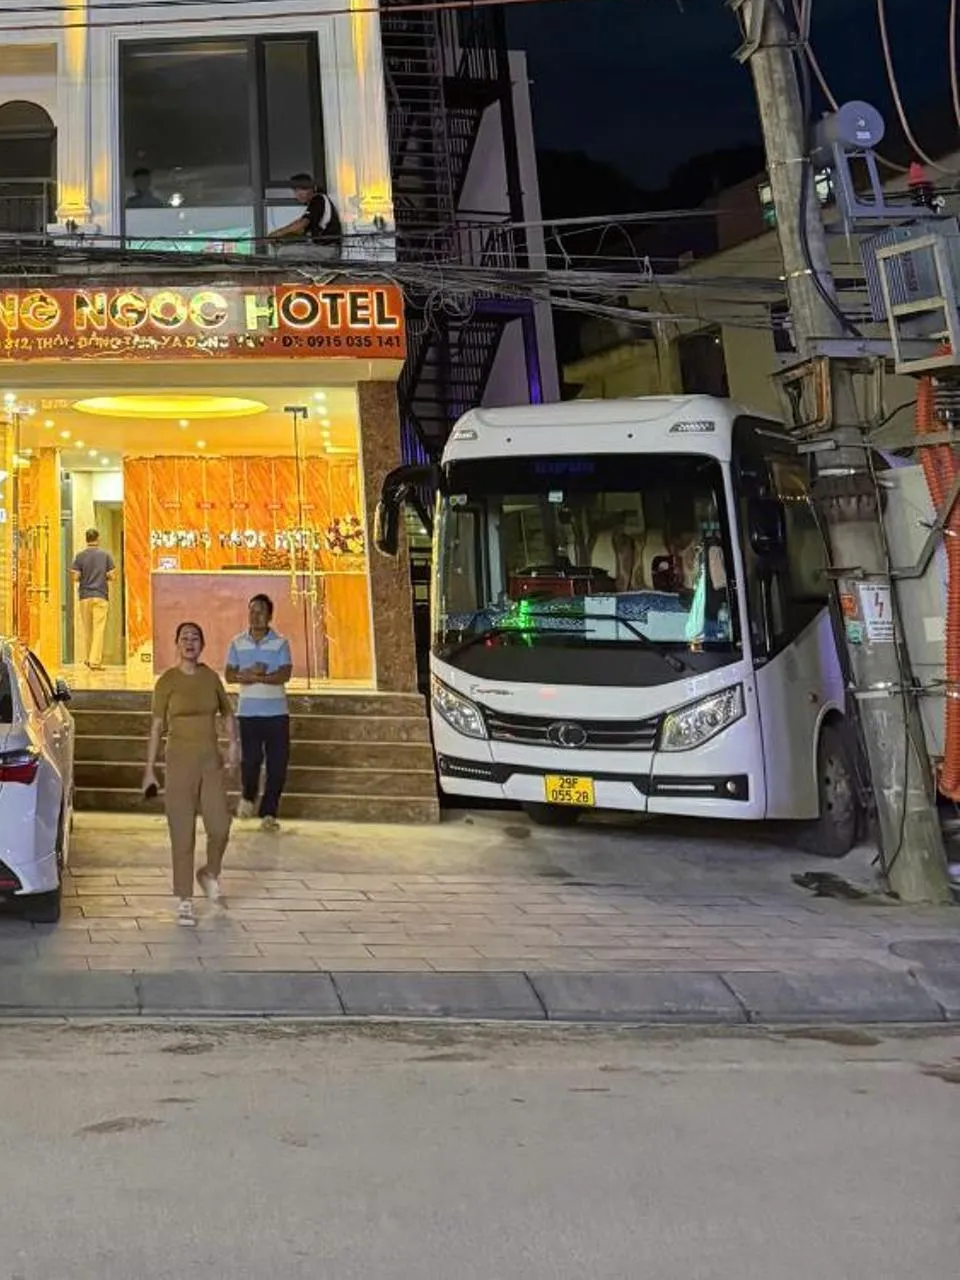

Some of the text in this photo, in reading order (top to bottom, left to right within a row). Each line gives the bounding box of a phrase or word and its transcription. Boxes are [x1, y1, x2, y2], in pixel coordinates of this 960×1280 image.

[74, 291, 228, 330] NGOC
[244, 289, 399, 330] HOTEL
[307, 335, 342, 348] 0915
[346, 335, 372, 348] 035
[377, 335, 401, 348] 141
